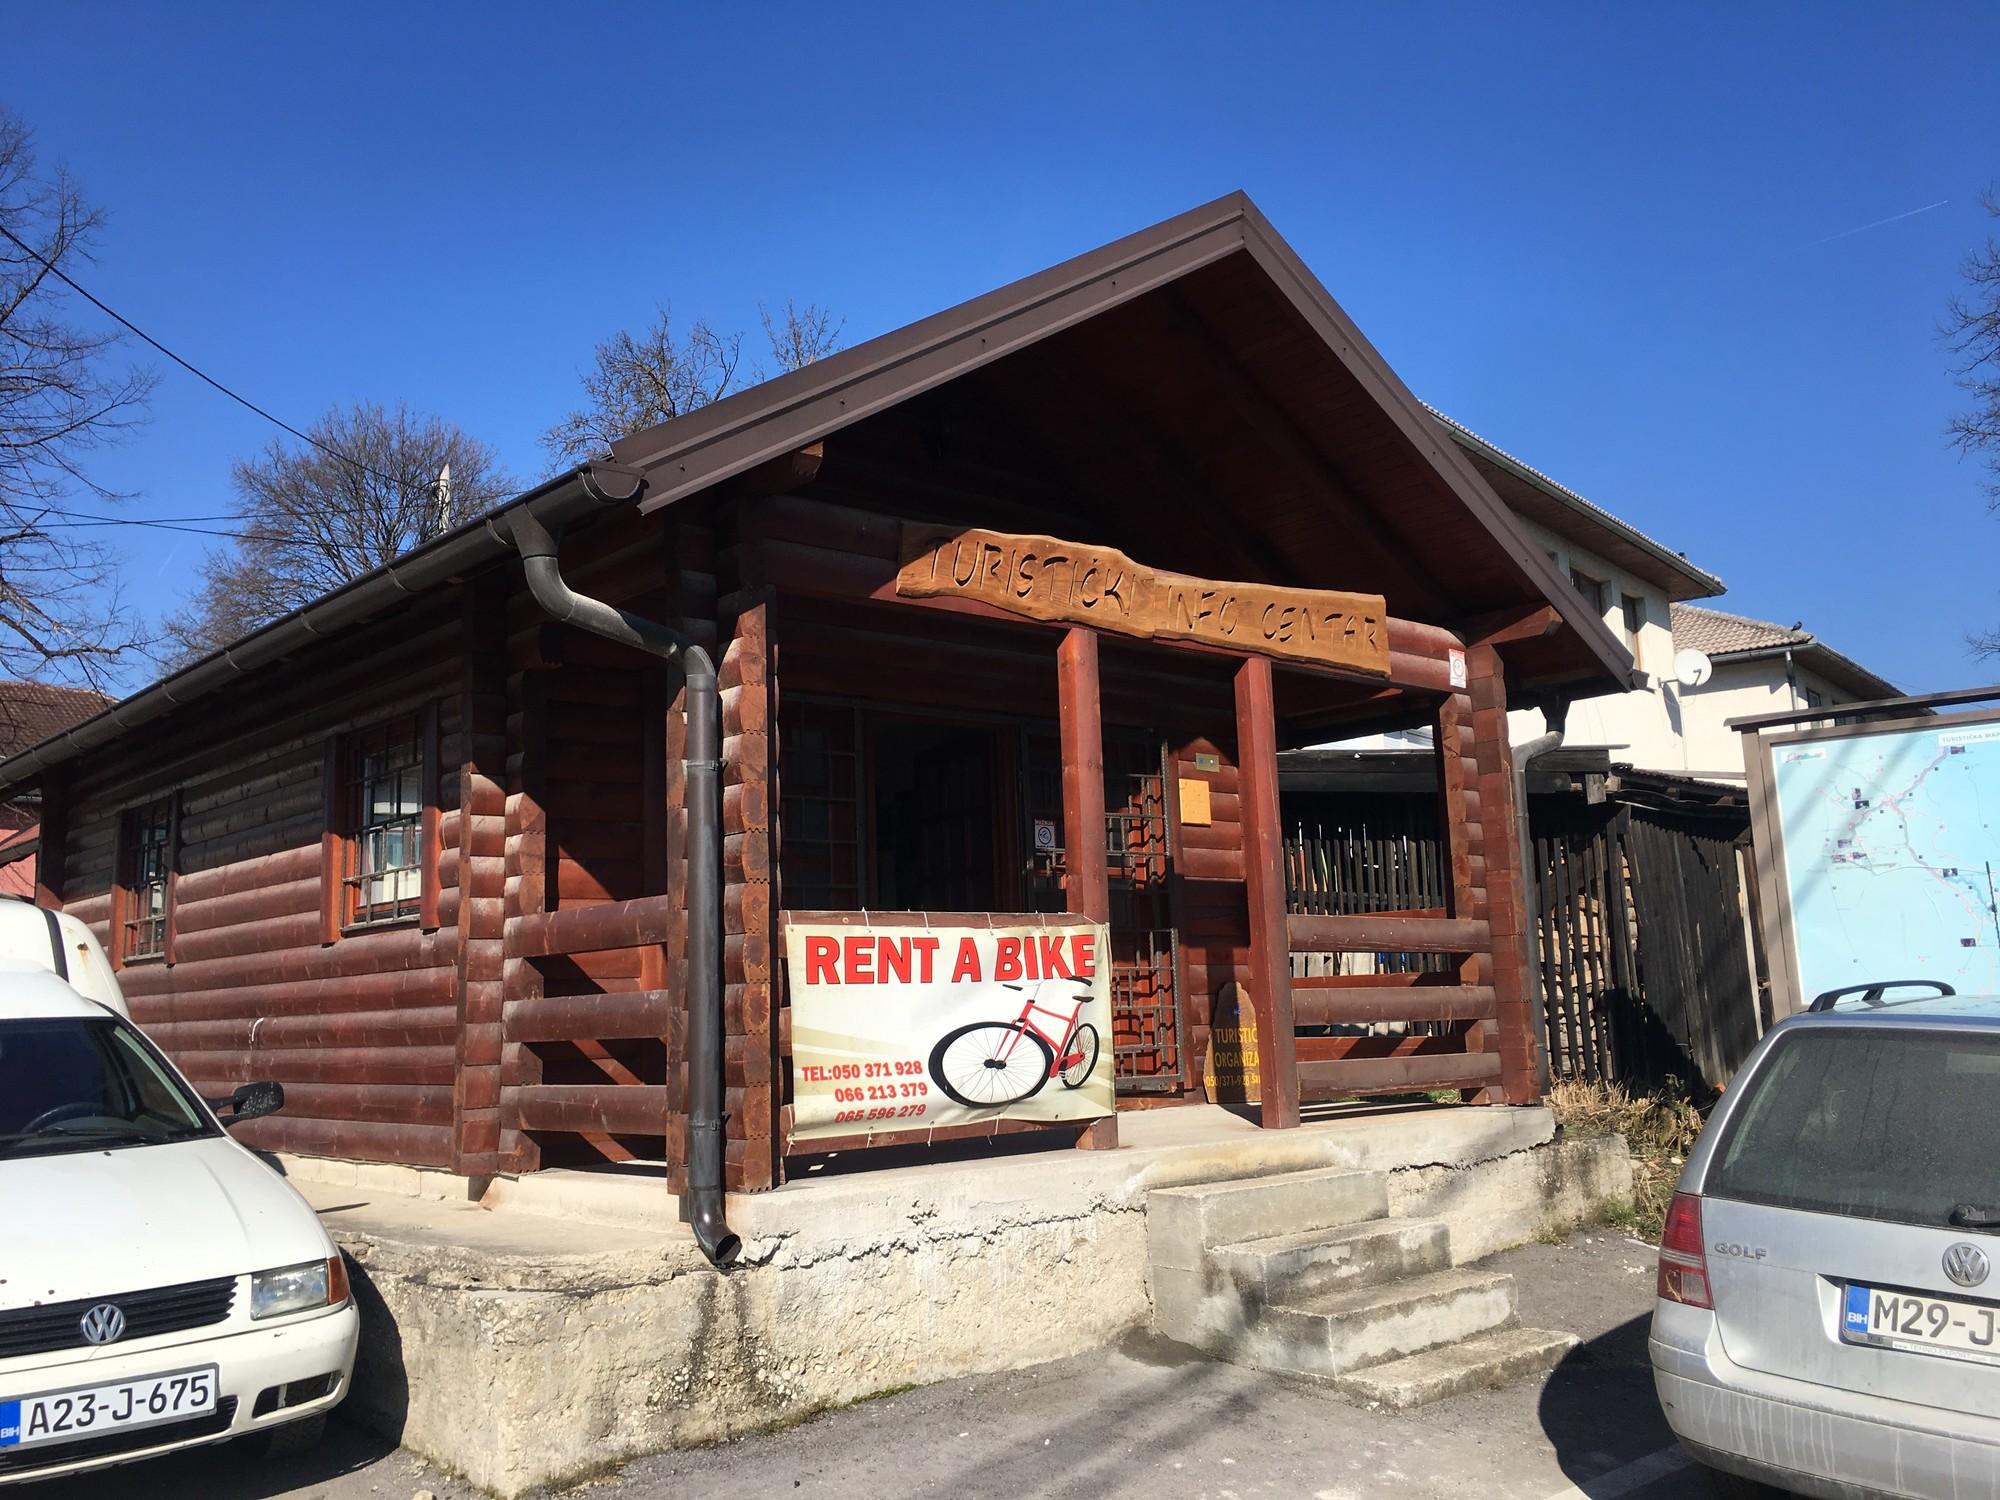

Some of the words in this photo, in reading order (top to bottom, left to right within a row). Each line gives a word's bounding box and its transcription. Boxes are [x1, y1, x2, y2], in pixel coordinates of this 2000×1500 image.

[1166, 585, 1239, 635] INFO
[1262, 602, 1380, 655] CENTAR
[805, 935, 940, 985] RENT
[951, 937, 982, 983] A
[994, 934, 1096, 982] BIKE
[801, 1064, 861, 1082] TEL:050
[864, 1062, 893, 1078] 371
[894, 1060, 923, 1076] 928
[834, 1087, 865, 1103] 066
[867, 1084, 897, 1100] 213
[900, 1082, 928, 1098] 379
[834, 1109, 865, 1123] 065
[866, 1106, 896, 1121] 596
[897, 1103, 926, 1118] 279
[1713, 1239, 1767, 1260] GOLF
[1848, 1311, 1867, 1324] BIH
[1873, 1294, 2000, 1346] M29-J
[28, 1374, 209, 1436] A23-J-675
